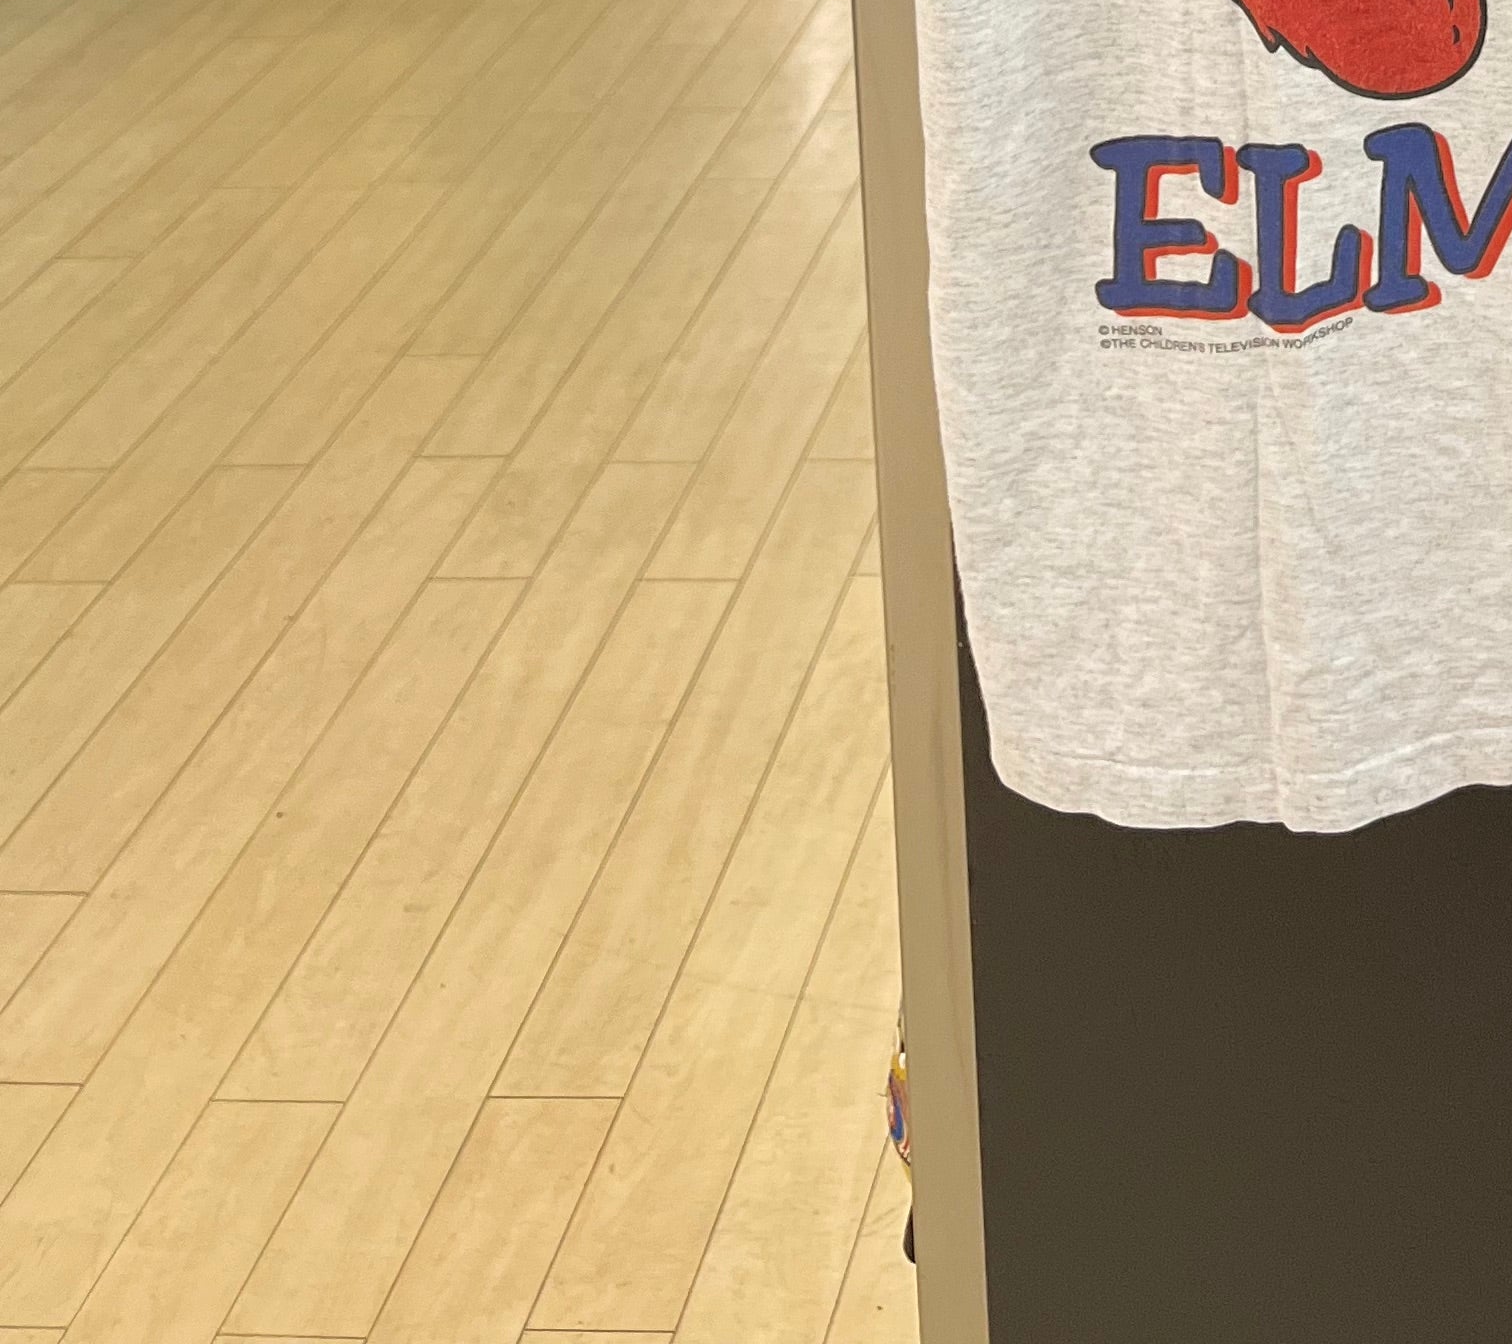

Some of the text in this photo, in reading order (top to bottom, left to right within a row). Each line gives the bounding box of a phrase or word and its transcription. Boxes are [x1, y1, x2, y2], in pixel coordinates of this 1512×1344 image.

[1111, 324, 1163, 336] HENSON
[1208, 337, 1281, 354] TELEVISION
[1281, 316, 1355, 349] WORKSHOP
